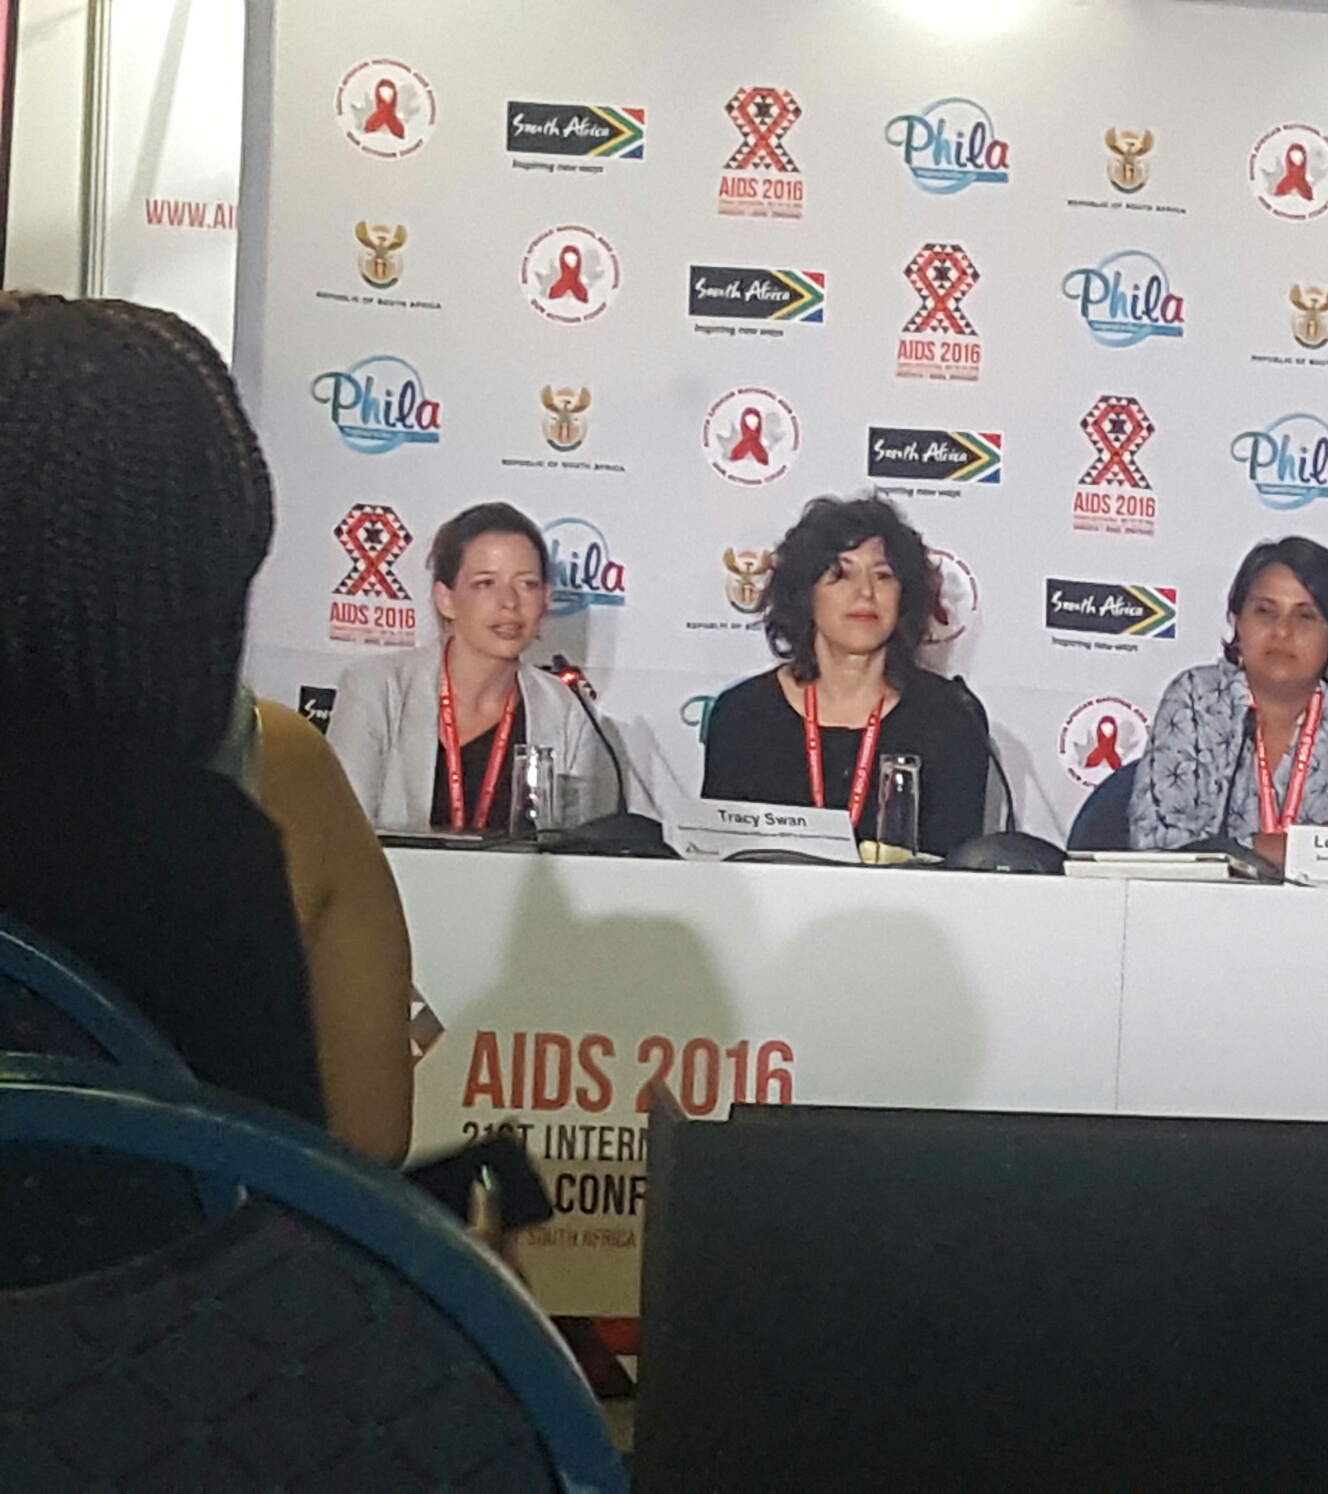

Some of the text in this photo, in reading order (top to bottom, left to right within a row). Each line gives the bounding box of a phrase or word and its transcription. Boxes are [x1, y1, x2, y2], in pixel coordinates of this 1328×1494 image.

[512, 113, 610, 138] South Africa
[884, 114, 1010, 169] Phila
[719, 176, 804, 201] AIDS 2016
[695, 277, 791, 302] South Africa
[1062, 267, 1185, 324] Phila
[897, 339, 980, 363] AIDS 2016
[312, 370, 441, 430] Phila
[874, 438, 968, 463] South Africa
[1074, 491, 1156, 518] AIDS 2016
[548, 536, 626, 593] hila
[329, 601, 416, 629] AIDS 2016
[1051, 591, 1144, 617] South Africa
[717, 809, 808, 828] Tracy Swan
[462, 1029, 796, 1117] AIDS 2016
